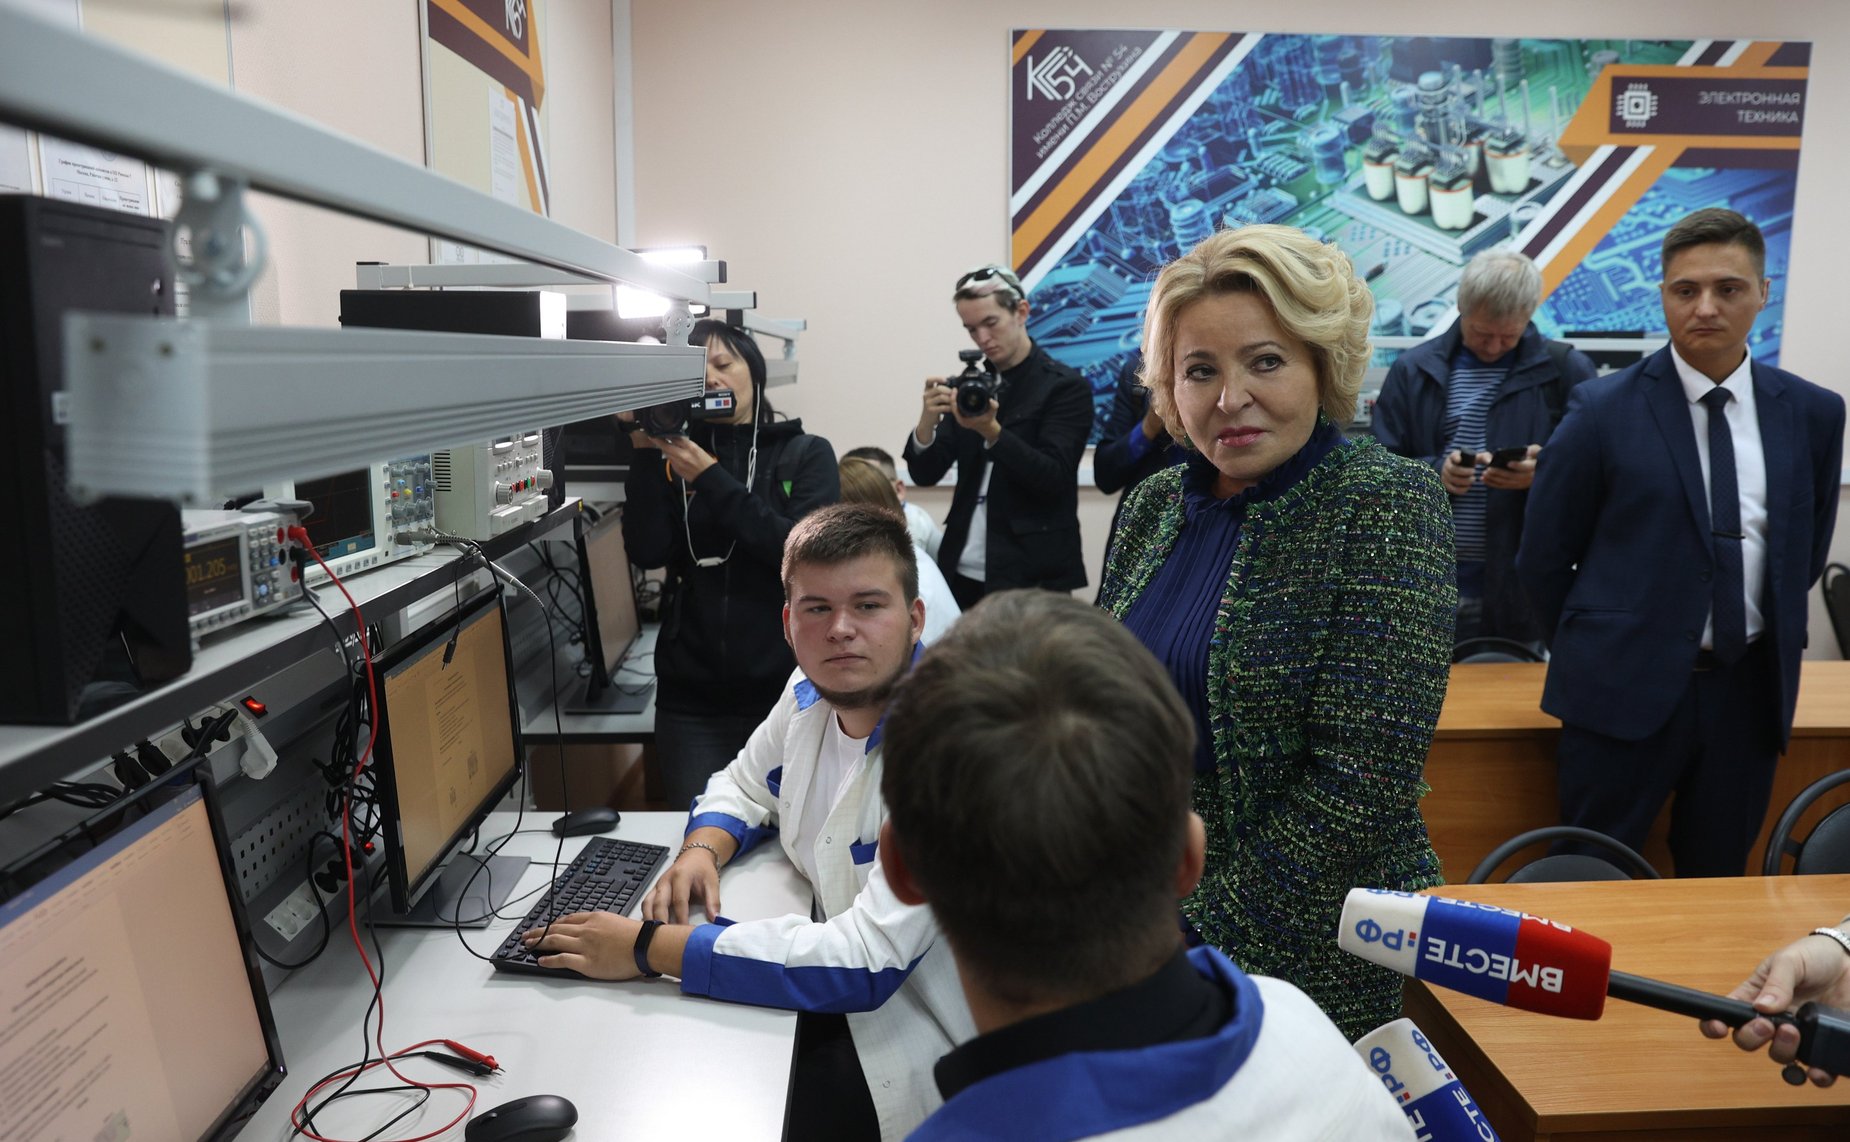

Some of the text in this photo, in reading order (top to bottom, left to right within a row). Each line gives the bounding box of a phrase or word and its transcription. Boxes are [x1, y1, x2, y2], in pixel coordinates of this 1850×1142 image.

[1033, 99, 1078, 144] Колледж
[1075, 70, 1105, 100] связи
[1112, 44, 1128, 60] 54
[1036, 123, 1070, 159] имени
[1086, 46, 1142, 104] Вострухина
[1699, 91, 1800, 105] ЭЛЕКТРОННАЯ
[1737, 110, 1799, 124] ТЕХНИКА
[1425, 937, 1564, 993] ВМЕСТЕ
